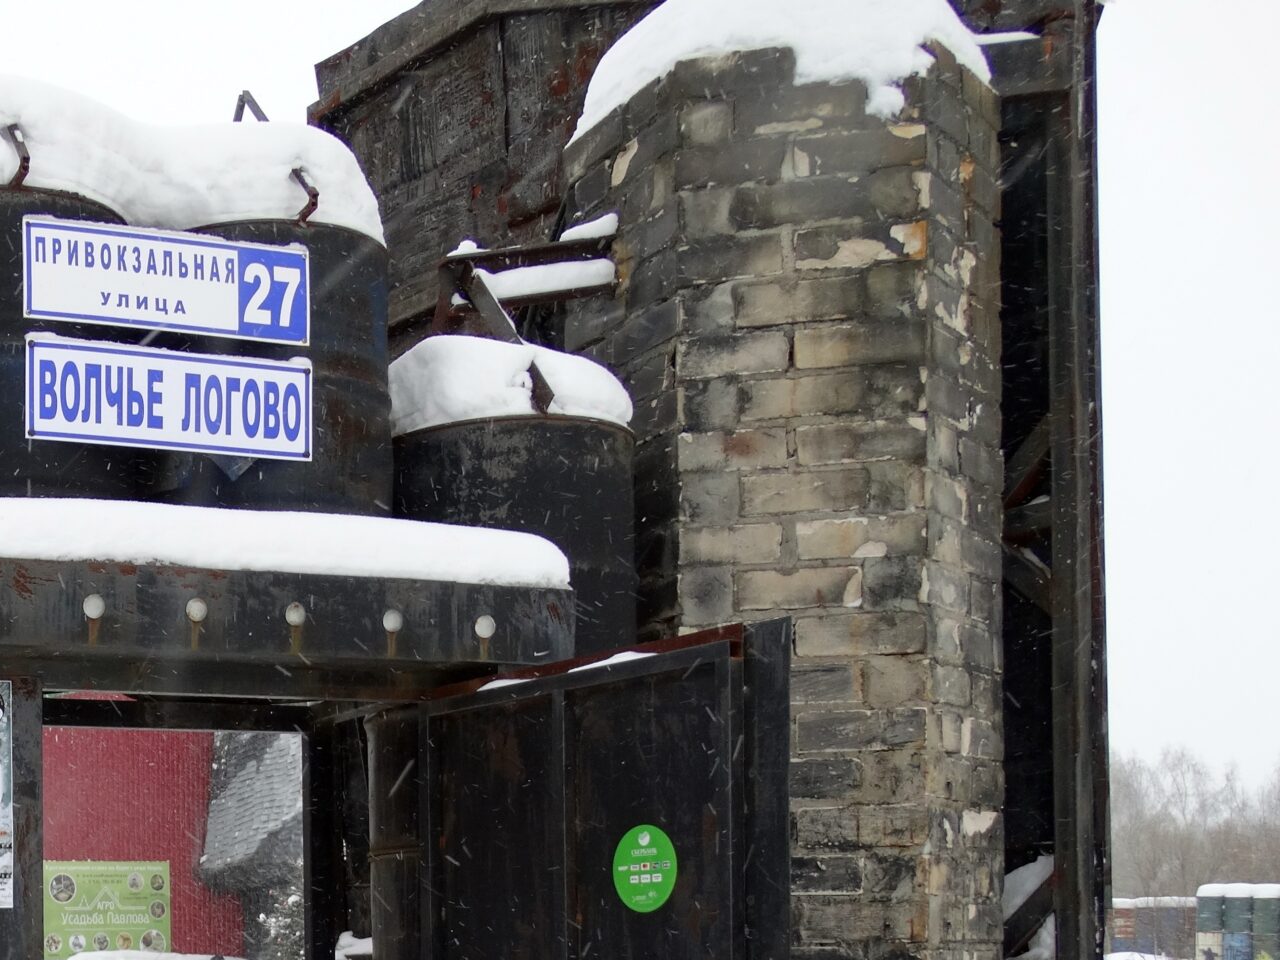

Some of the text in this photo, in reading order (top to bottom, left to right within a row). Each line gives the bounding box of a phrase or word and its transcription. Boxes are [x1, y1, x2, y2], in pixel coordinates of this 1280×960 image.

[35, 236, 301, 327] ПРИВОКЗАЛЬНАЯ 27
[101, 291, 186, 315] УЛИЦА
[39, 359, 301, 442] ВОЛЧЬЕ ЛОГОВО
[62, 912, 150, 925] Усадьба Павлова
